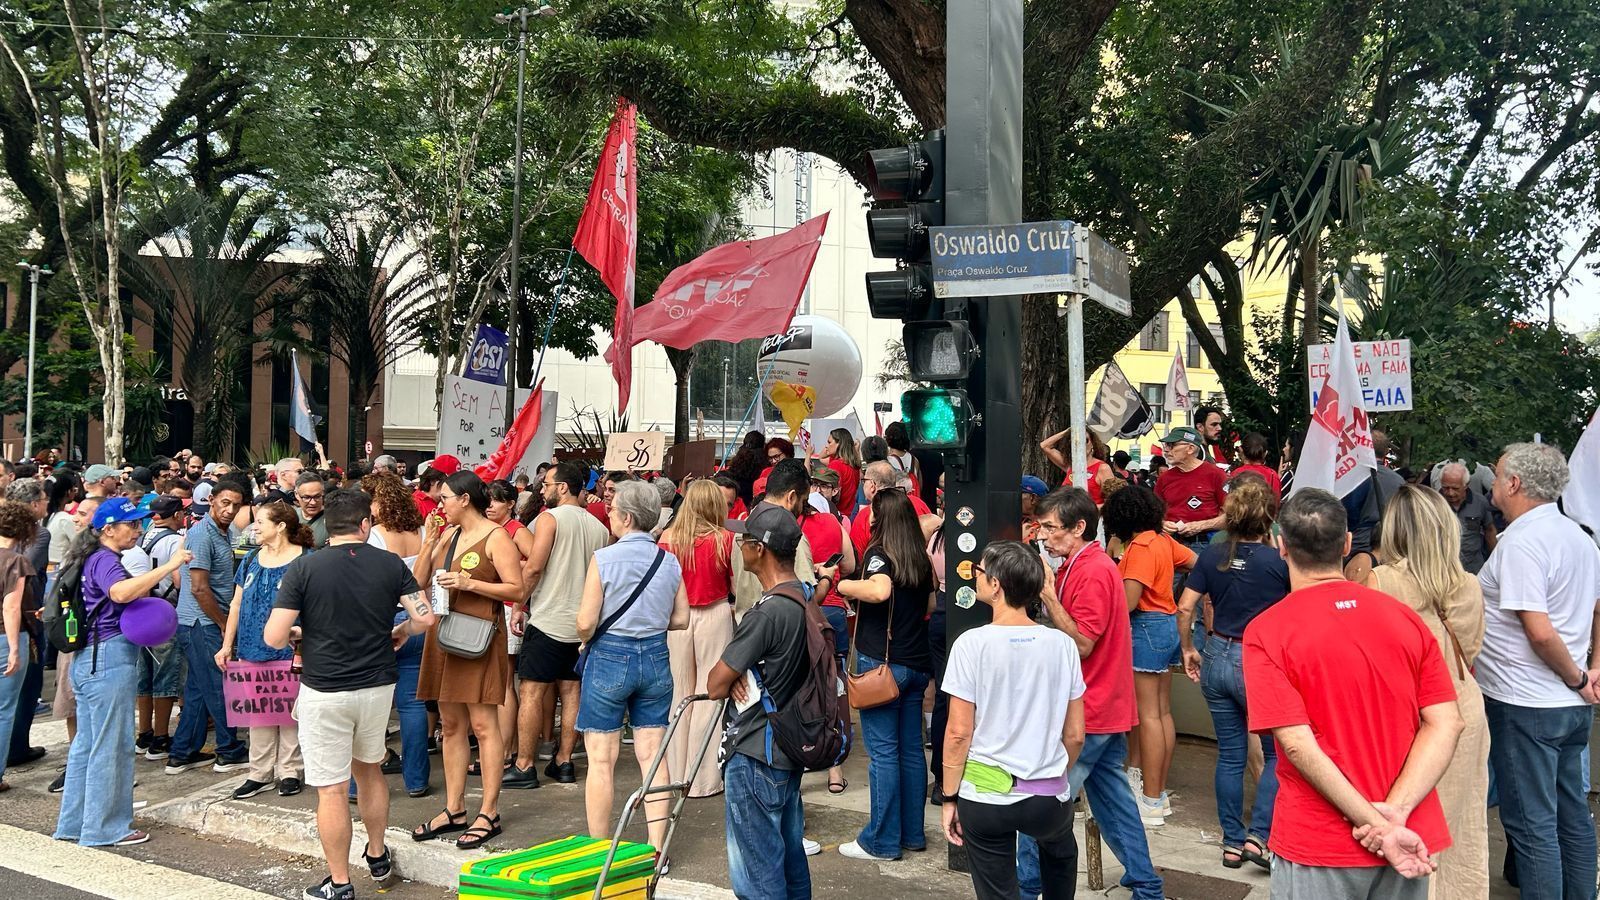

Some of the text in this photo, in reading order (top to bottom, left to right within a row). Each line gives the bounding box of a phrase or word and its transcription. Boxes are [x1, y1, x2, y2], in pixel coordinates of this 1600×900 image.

[934, 228, 1071, 257] Oswaldo Cruz
[937, 264, 1029, 278] Praça Oswaldo Cruz
[452, 381, 479, 415] SEM
[460, 418, 474, 432] POR
[456, 444, 470, 457] FIM
[1334, 600, 1357, 610] MST
[255, 685, 289, 694] PARA
